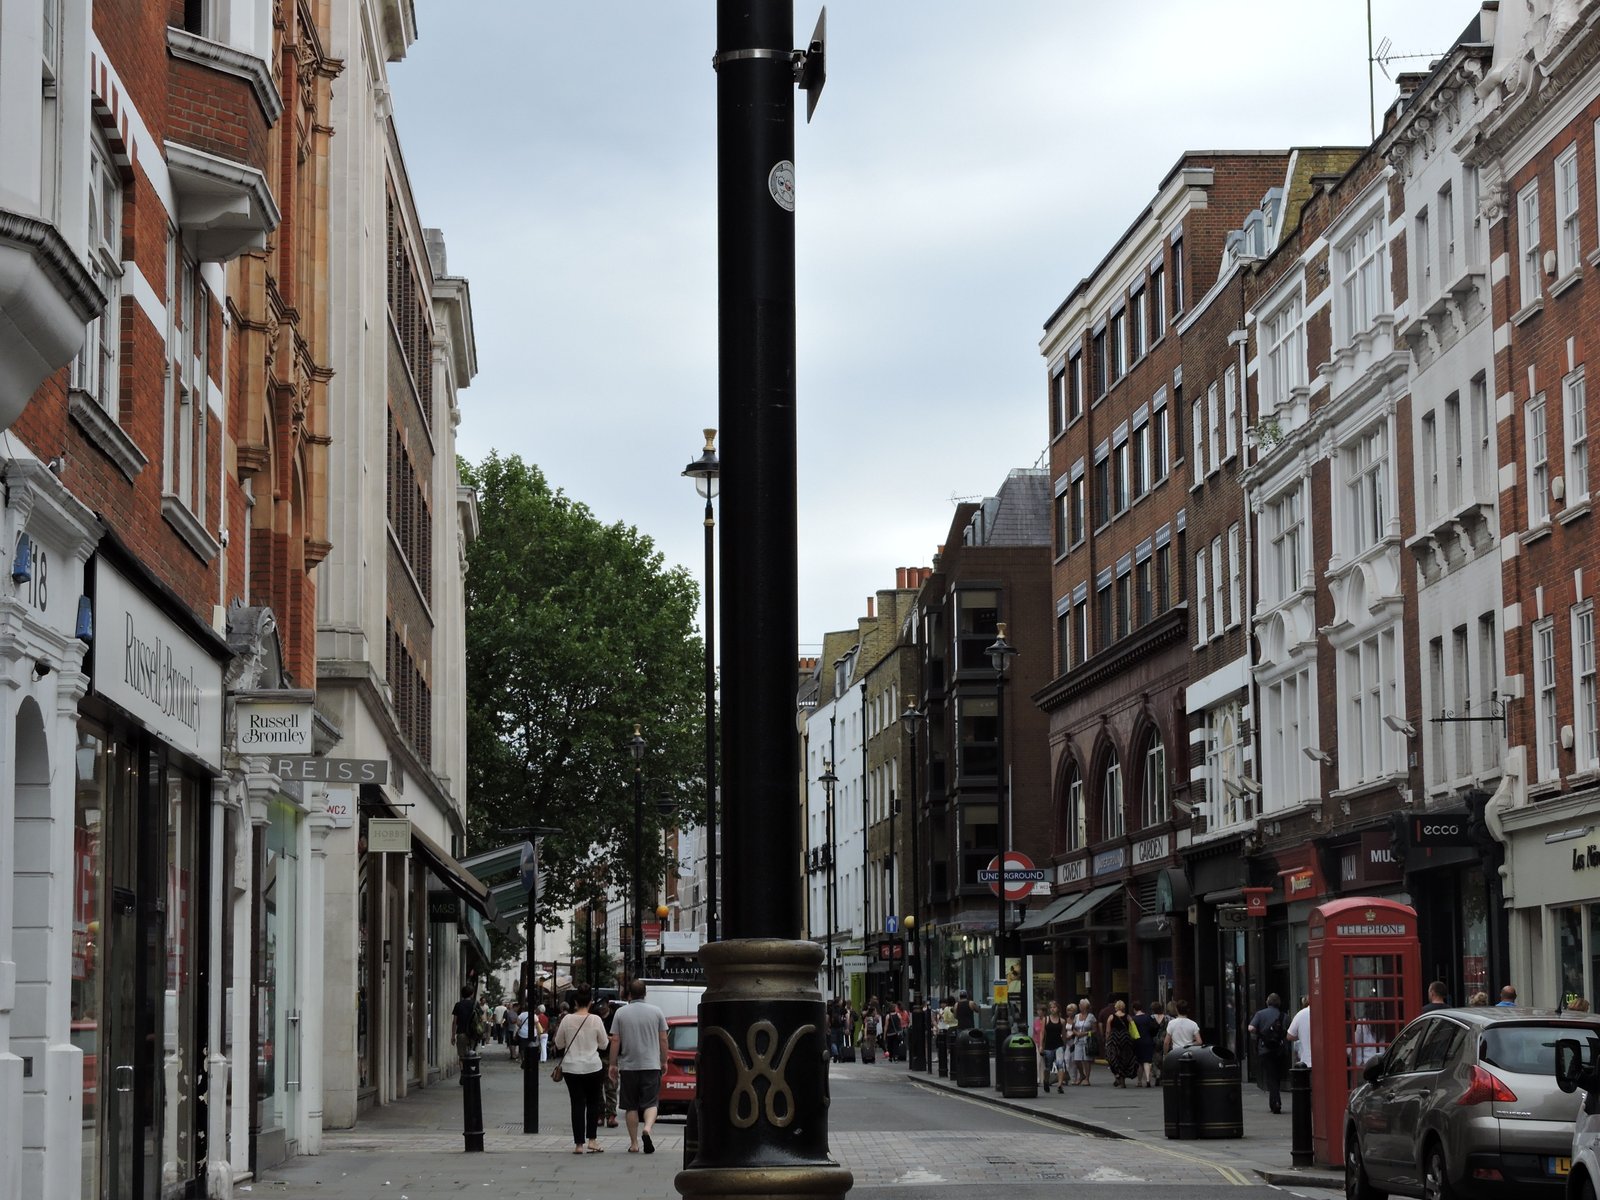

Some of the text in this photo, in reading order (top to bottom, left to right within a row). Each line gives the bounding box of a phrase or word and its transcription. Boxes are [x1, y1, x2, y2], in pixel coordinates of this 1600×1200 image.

[124, 611, 161, 706] Russell
[250, 714, 298, 729] Russell
[278, 759, 375, 780] REISS
[326, 805, 346, 815] WC2
[374, 830, 406, 838] HOBBS
[1423, 825, 1459, 835] ecco
[1139, 838, 1163, 861] GARDEN
[980, 871, 1044, 881] UNDRGROUND
[1062, 862, 1081, 882] COVENT
[432, 903, 456, 913] M&S
[1340, 925, 1403, 934] TELEPHONE
